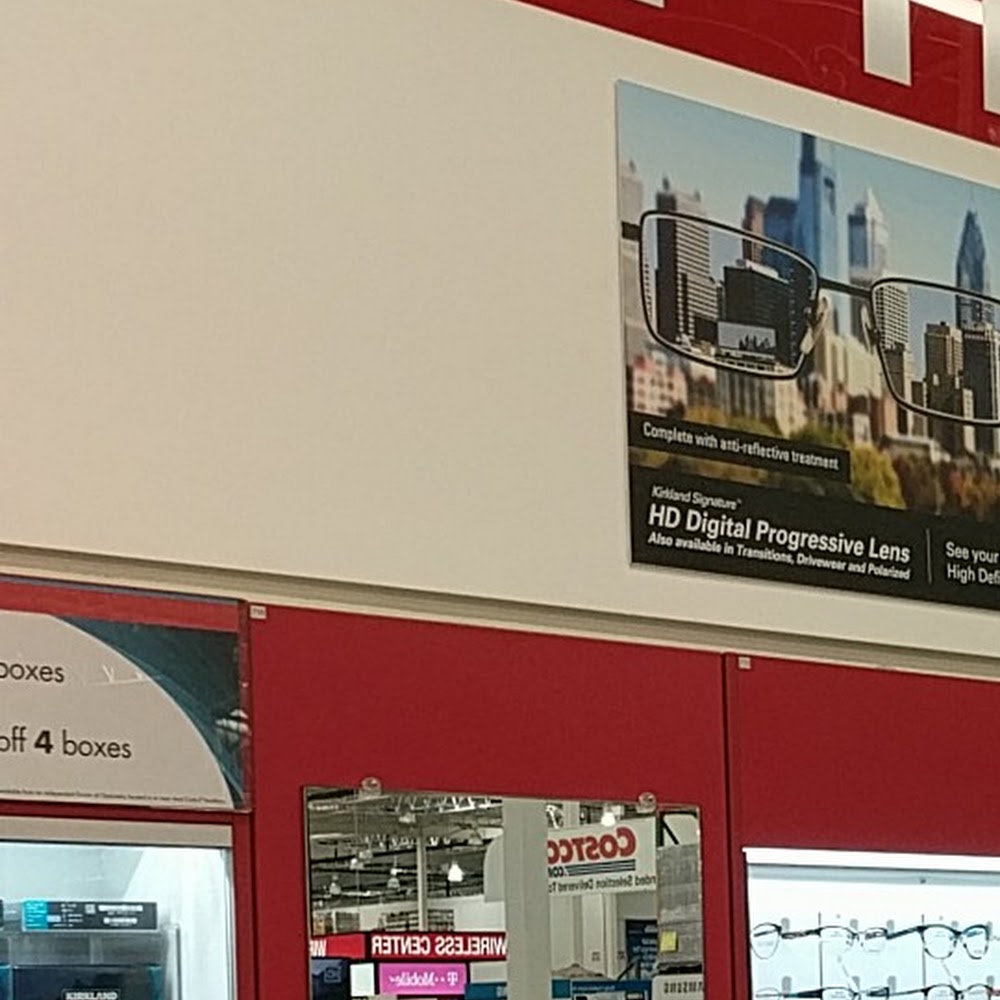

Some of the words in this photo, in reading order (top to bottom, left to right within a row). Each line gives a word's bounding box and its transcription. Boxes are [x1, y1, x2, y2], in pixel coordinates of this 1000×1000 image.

[643, 422, 693, 444] Complete
[695, 432, 718, 449] with
[720, 438, 790, 462] anti-reflective
[791, 451, 840, 470] treatment
[651, 485, 692, 503] Kirkland
[648, 503, 681, 529] HD
[685, 509, 752, 540] Digital
[755, 520, 865, 557] Progressive
[868, 536, 911, 563] Lens
[648, 531, 673, 547] Also
[675, 537, 722, 554] available
[723, 543, 735, 555] in
[736, 543, 795, 565] Transitions,
[796, 553, 847, 571] Drivewear
[847, 562, 866, 574] and
[867, 563, 911, 580] Polarized
[945, 541, 970, 561] See
[971, 550, 999, 564] your
[947, 563, 976, 585] High
[34, 731, 54, 754] 4
[62, 729, 132, 759] boxes
[65, 991, 118, 1000] KIRKLAND
